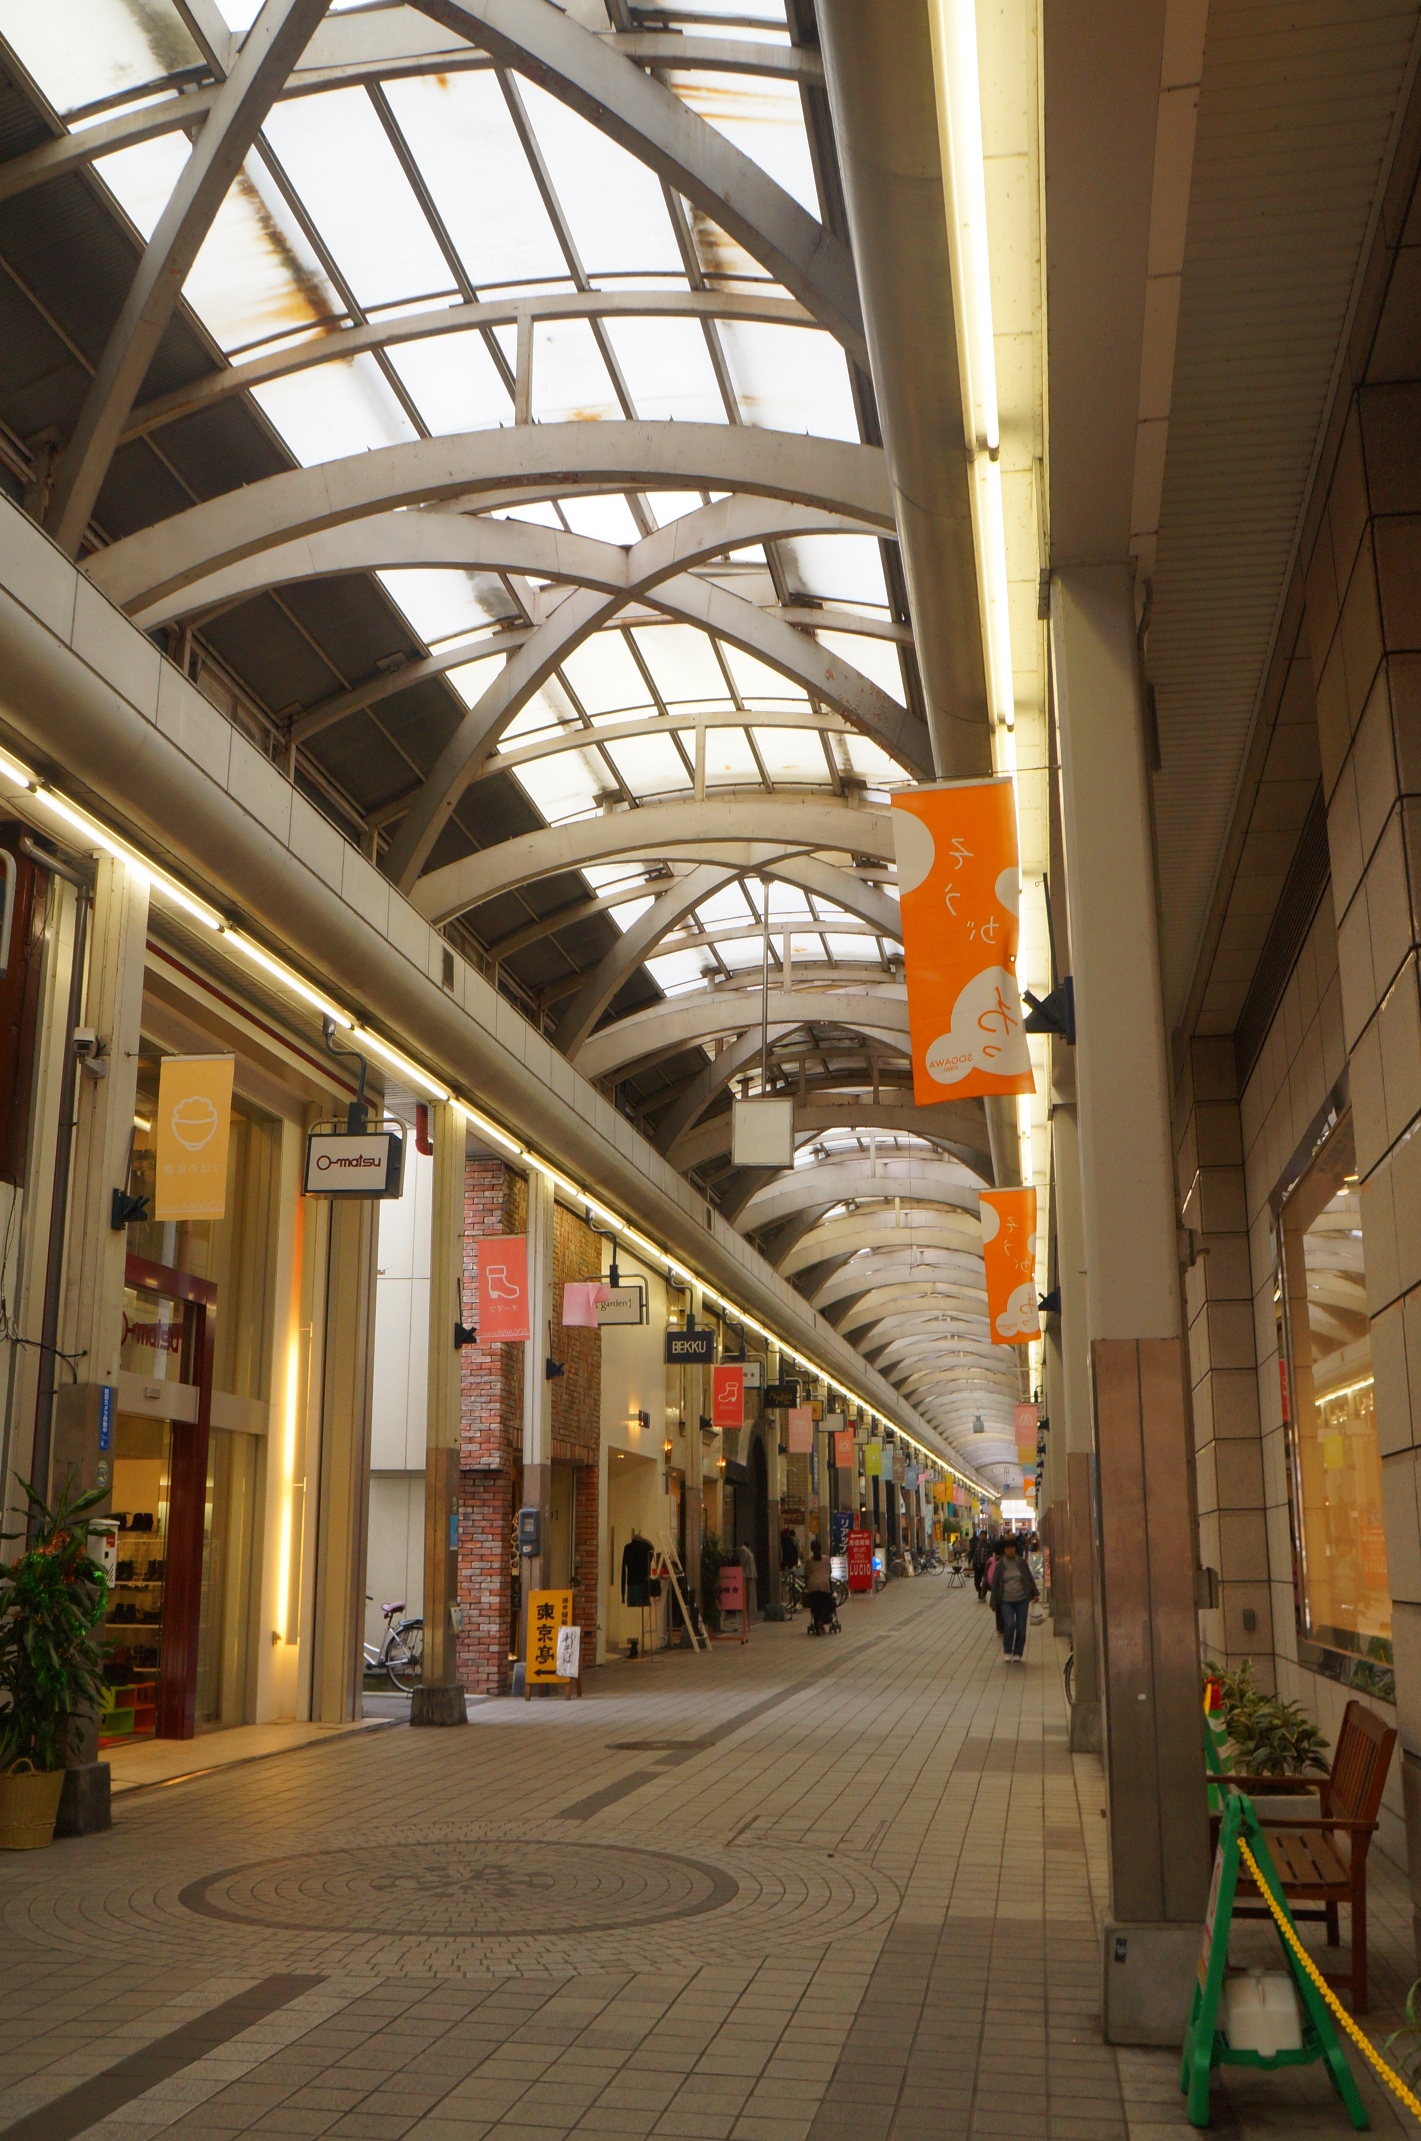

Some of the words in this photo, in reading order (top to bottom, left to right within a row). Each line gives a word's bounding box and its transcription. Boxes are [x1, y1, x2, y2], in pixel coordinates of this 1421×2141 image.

[316, 1154, 382, 1171] O-matsu
[672, 1341, 707, 1354] BEKKU
[850, 1564, 871, 1576] LUCIO
[536, 1602, 555, 1664] 東京亭
